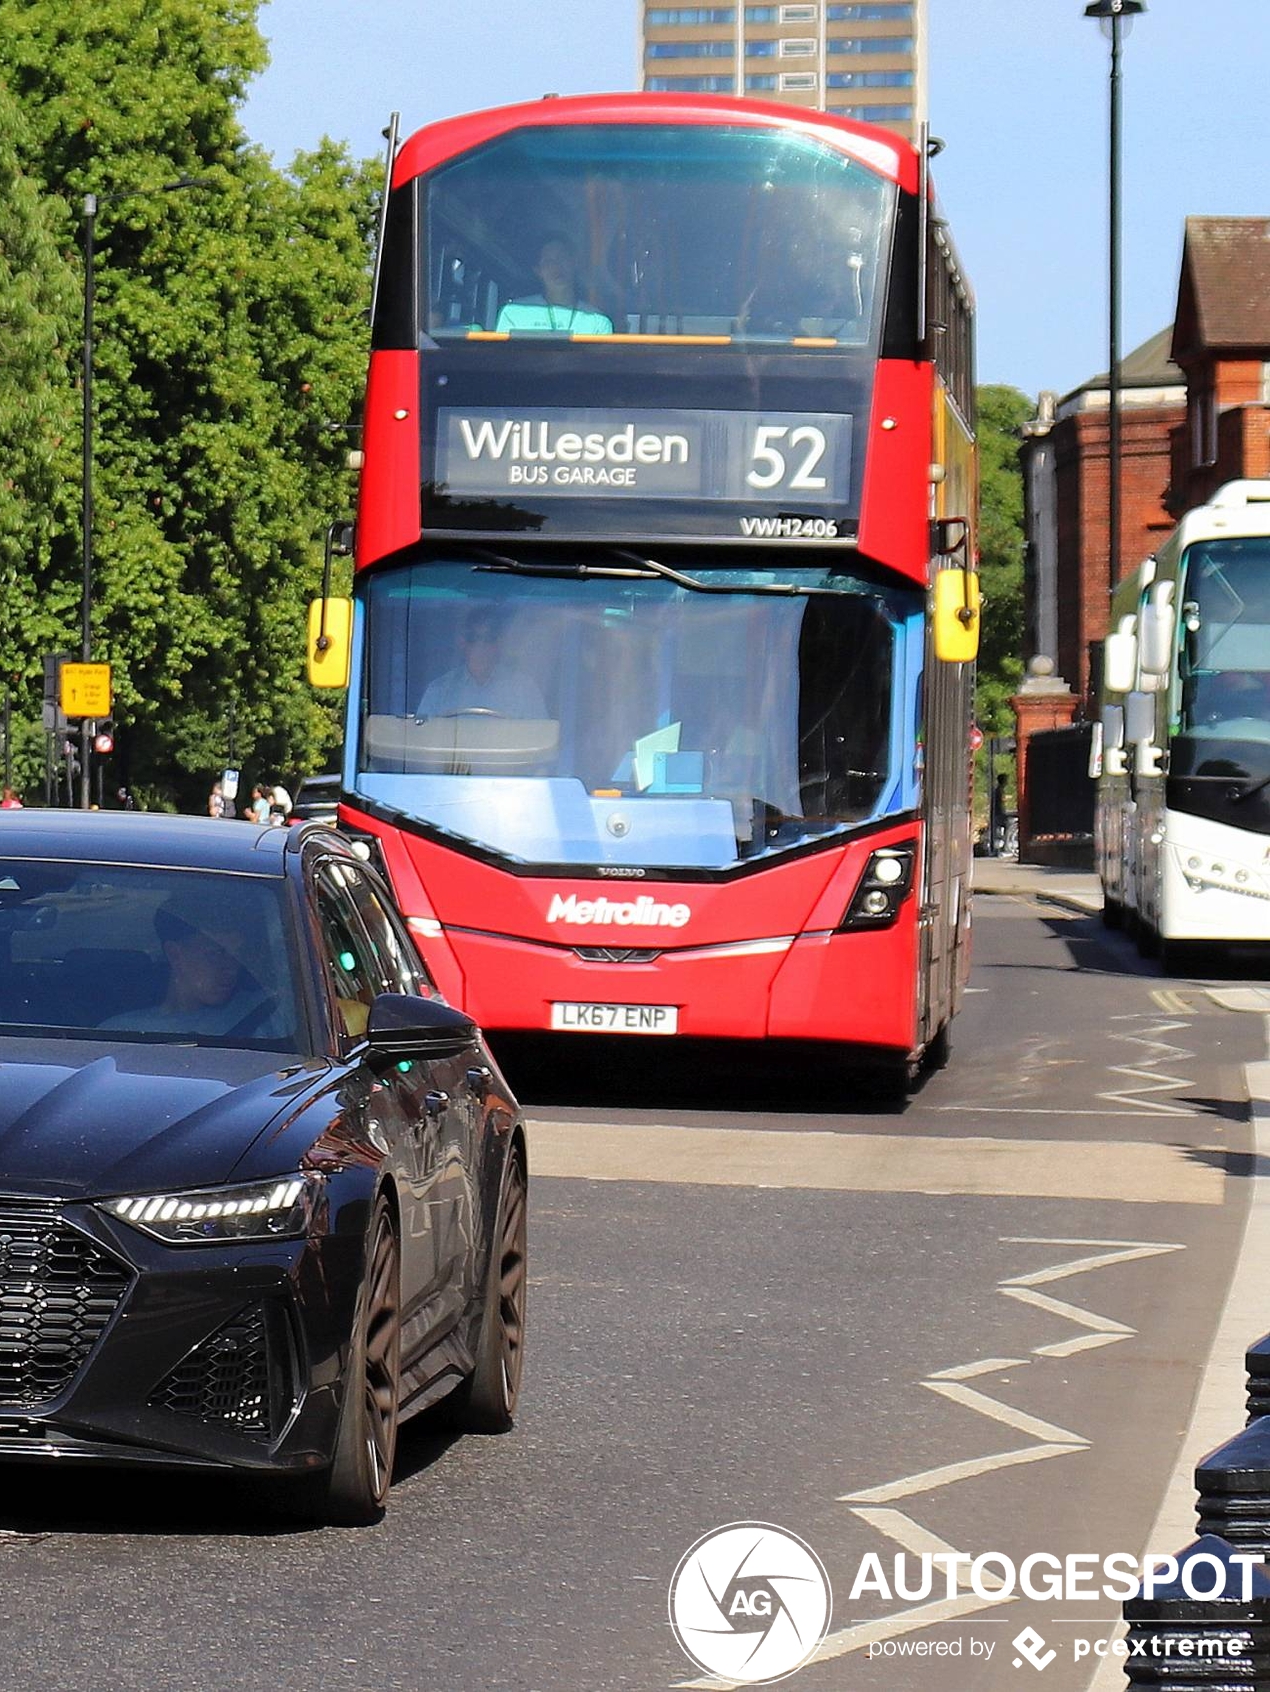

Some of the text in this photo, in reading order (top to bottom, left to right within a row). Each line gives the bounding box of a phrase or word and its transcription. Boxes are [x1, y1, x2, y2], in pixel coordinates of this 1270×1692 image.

[460, 420, 688, 464] Willesden
[745, 424, 827, 491] 52
[508, 464, 637, 487] BUS GARAGE
[740, 516, 838, 539] VWH2406
[596, 865, 646, 877] VOLVO
[546, 893, 691, 929] Metroline
[562, 1005, 667, 1029] LK67 ENP
